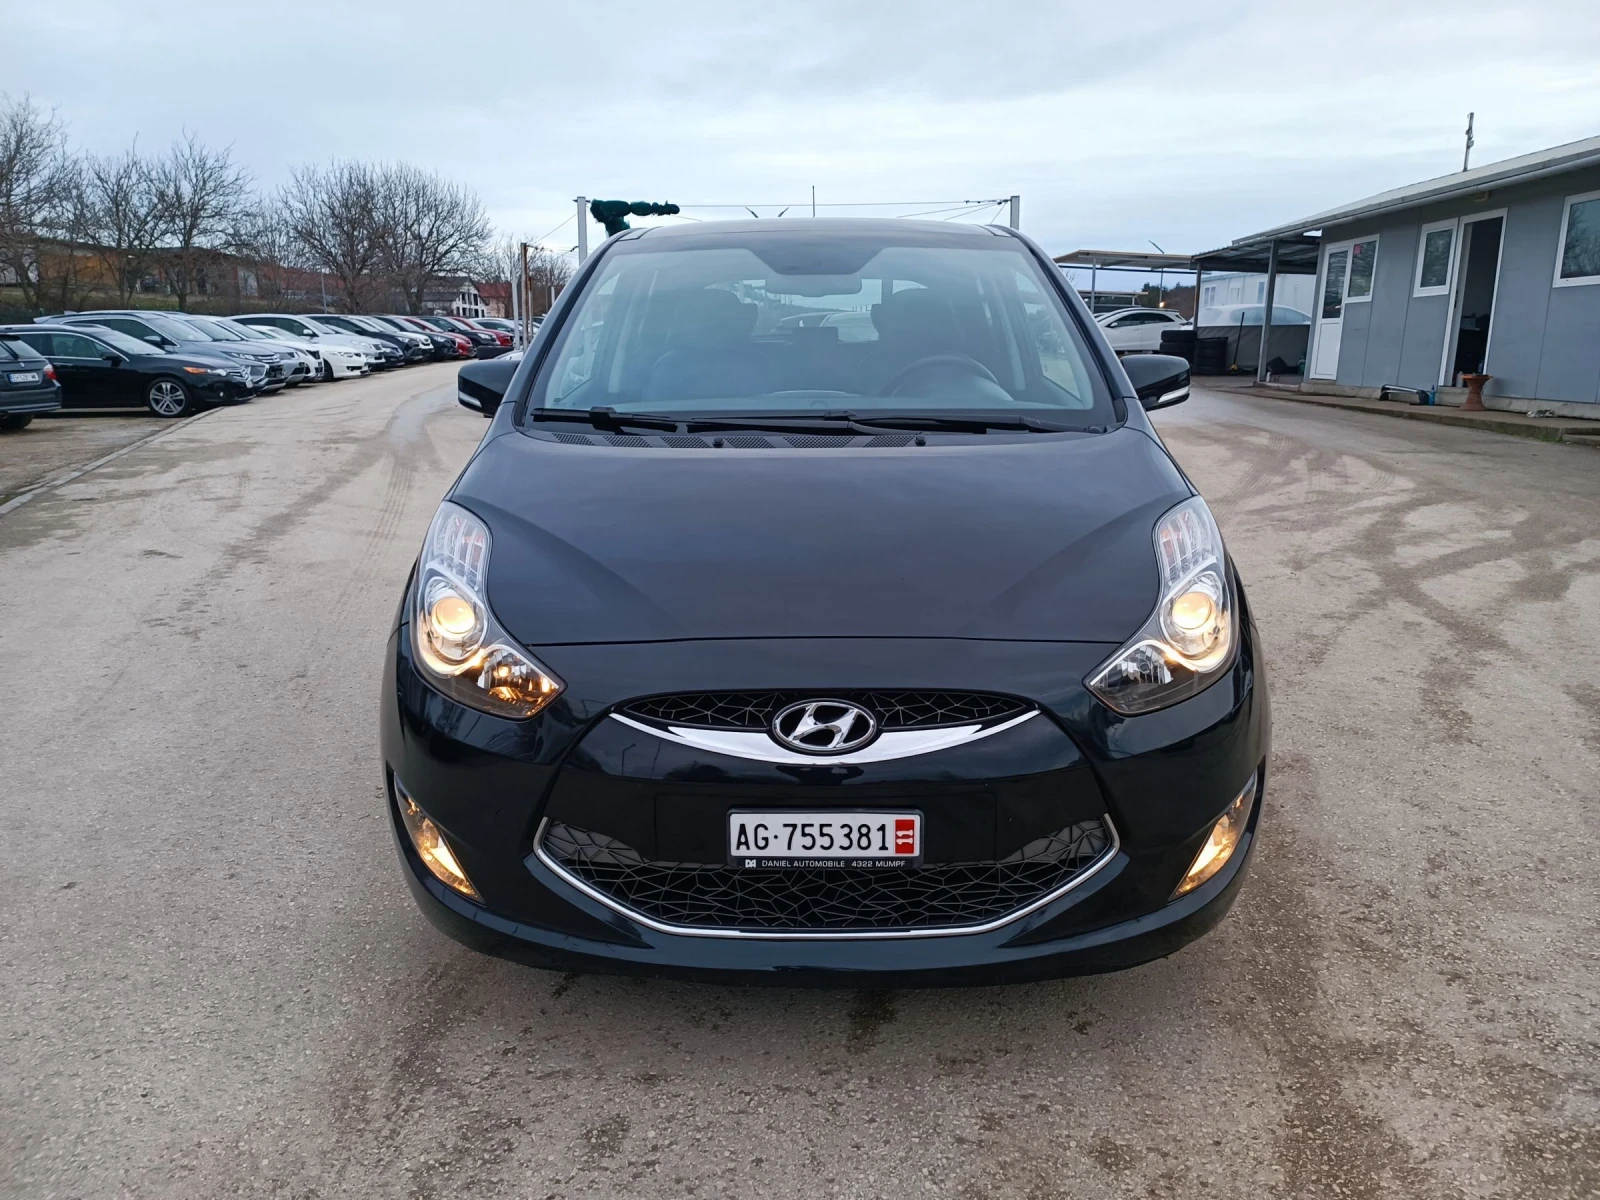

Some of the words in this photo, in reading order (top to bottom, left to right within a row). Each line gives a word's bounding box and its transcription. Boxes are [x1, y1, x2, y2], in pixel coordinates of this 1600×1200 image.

[761, 860, 792, 868] DANIEL
[793, 860, 846, 868] AUTOMOBILE
[851, 860, 873, 868] 4322
[875, 860, 906, 868] MUMPF
